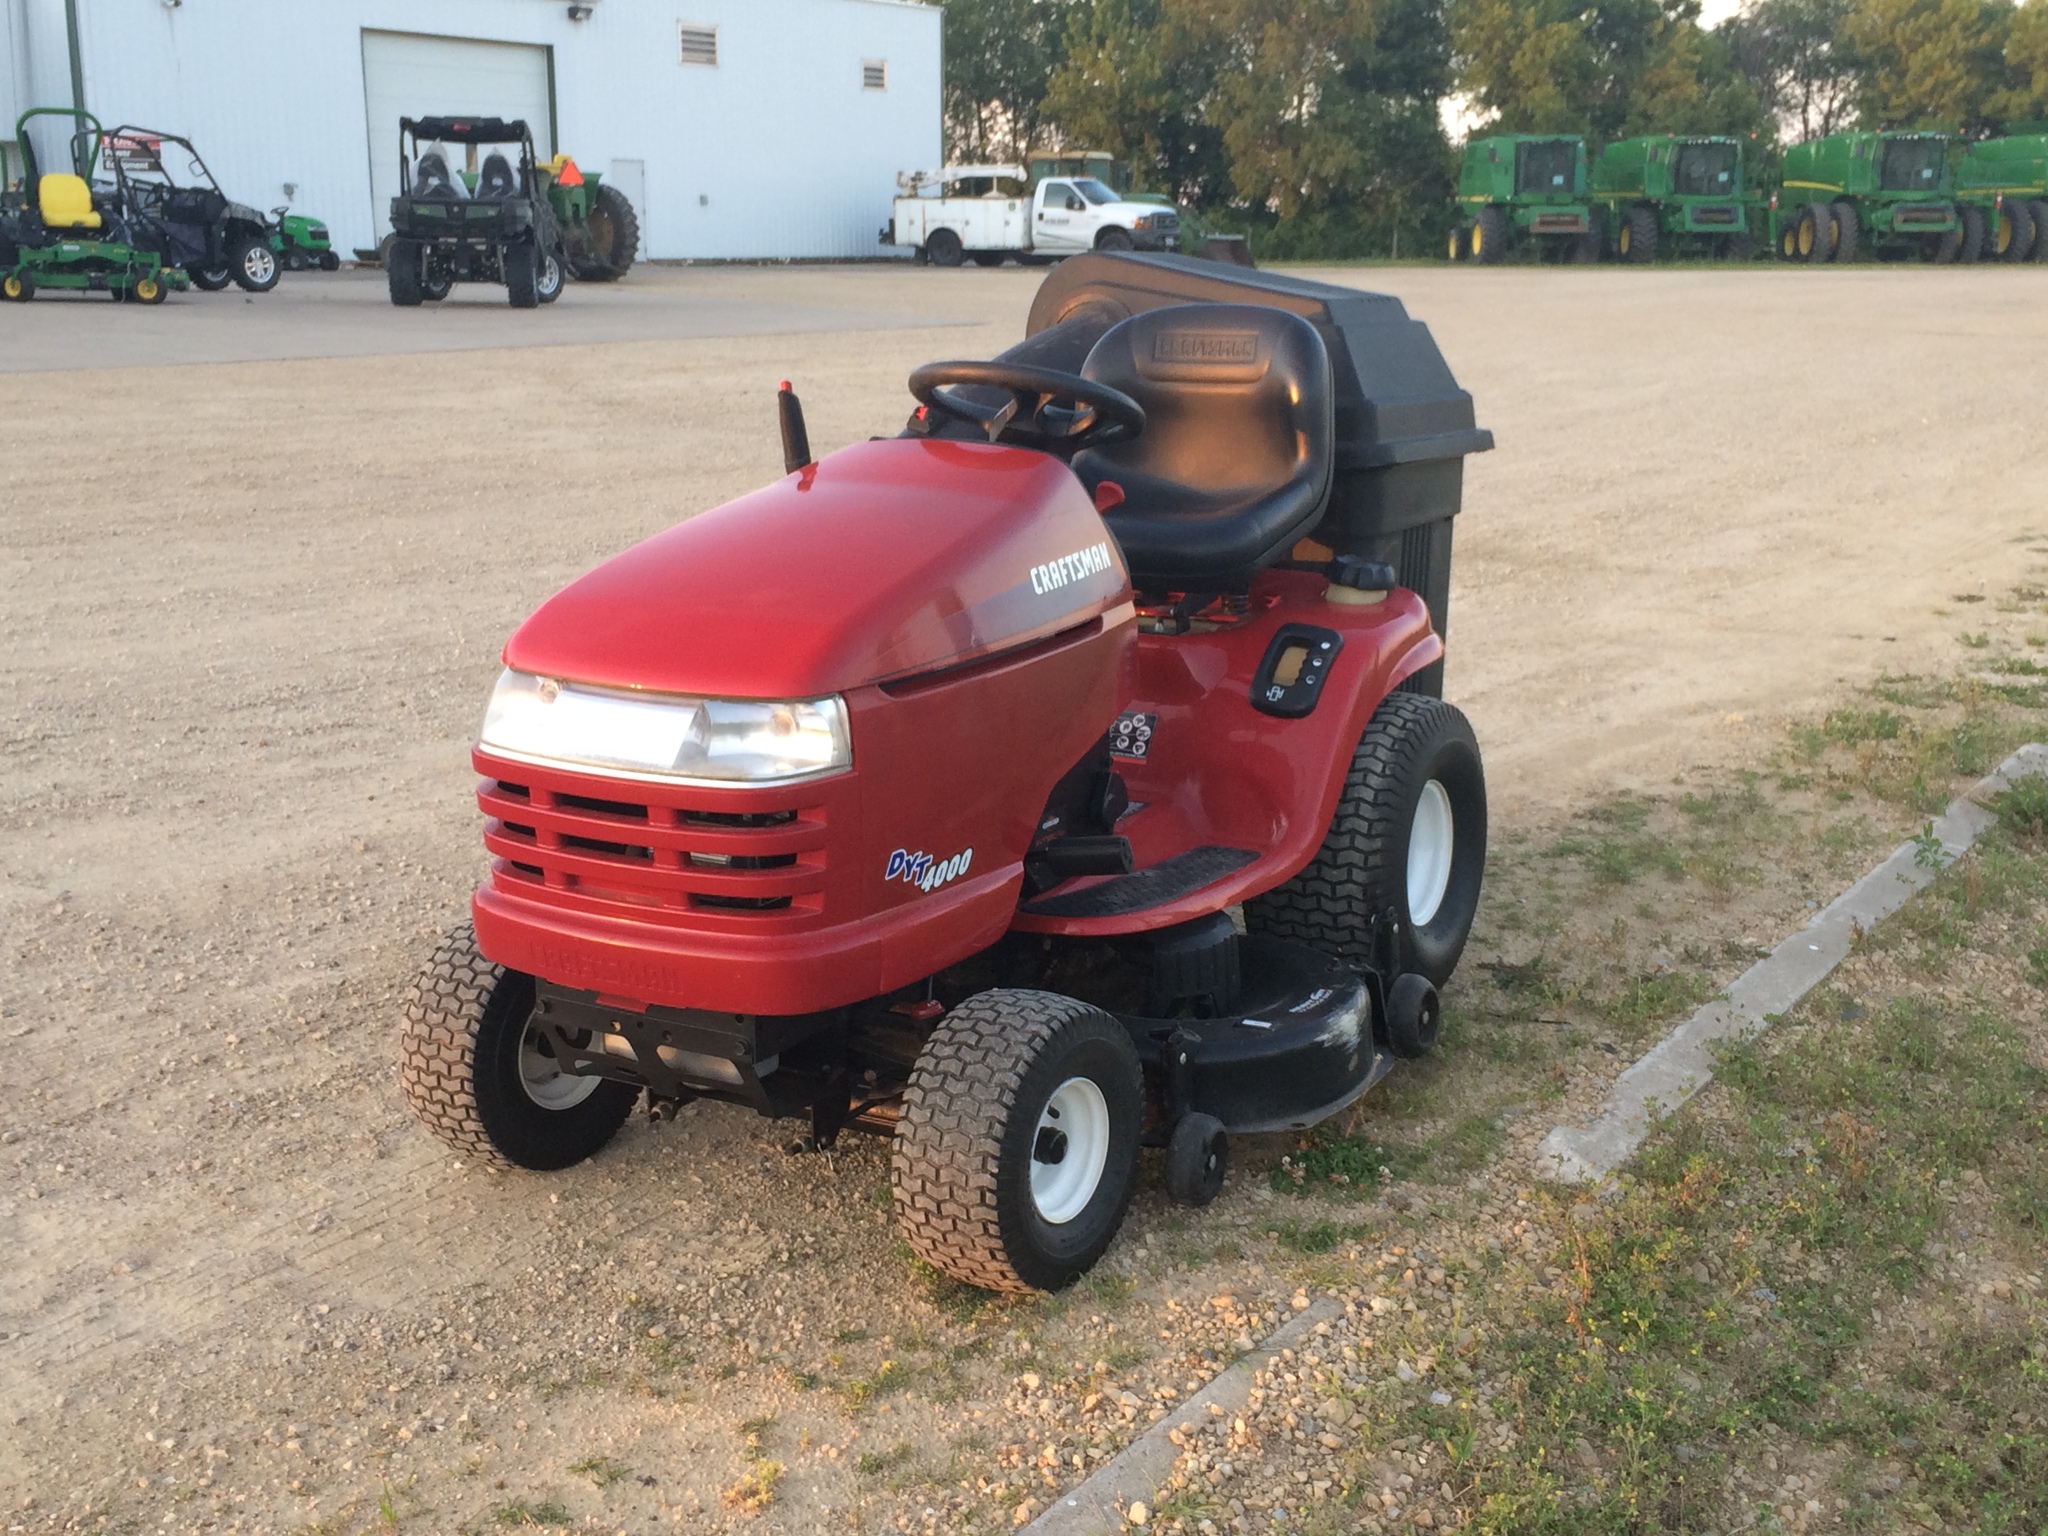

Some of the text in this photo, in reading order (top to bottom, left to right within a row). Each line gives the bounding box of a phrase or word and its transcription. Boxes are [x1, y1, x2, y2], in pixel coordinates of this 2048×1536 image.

[1030, 542, 1111, 595] CRAFTSMAN
[885, 847, 973, 893] DYT 4000
